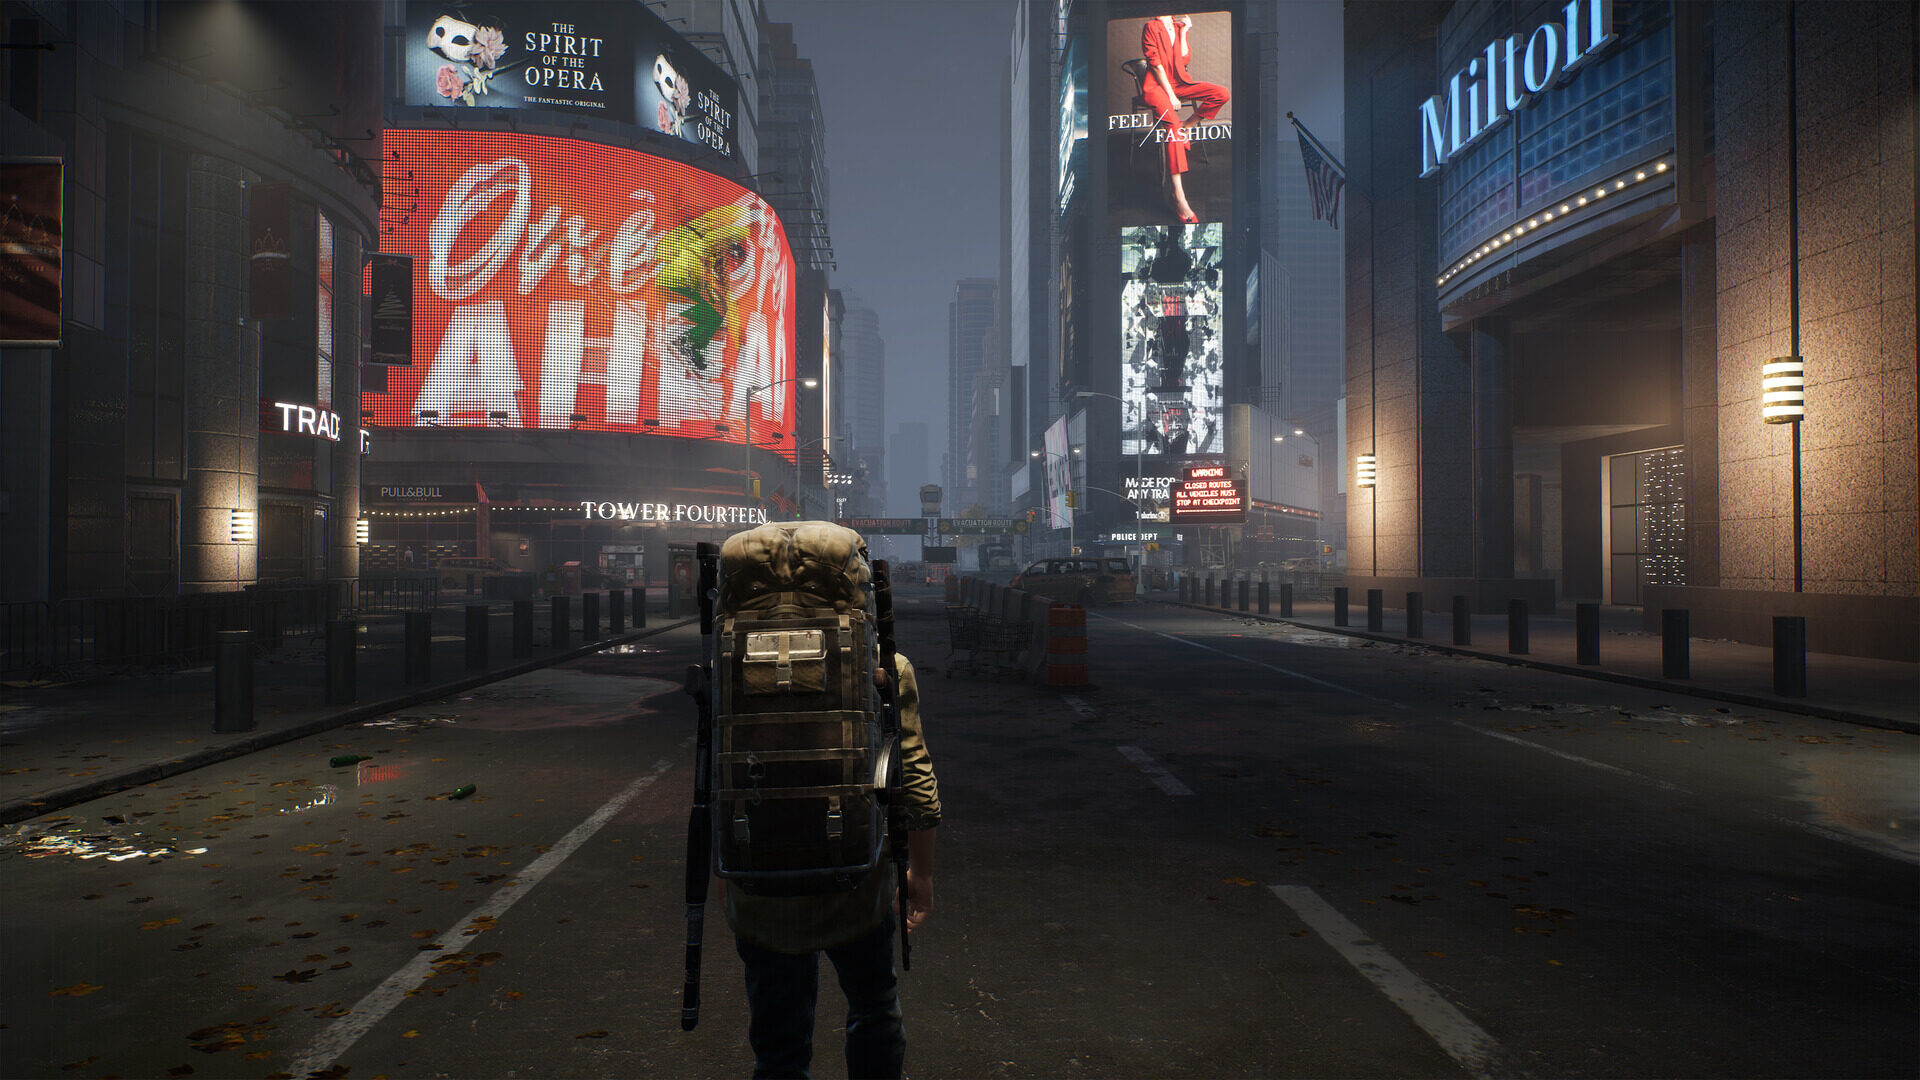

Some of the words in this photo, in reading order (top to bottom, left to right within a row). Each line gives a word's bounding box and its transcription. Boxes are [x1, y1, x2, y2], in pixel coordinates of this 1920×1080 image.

[551, 22, 575, 34] THE
[525, 32, 603, 57] SPIRIT
[542, 55, 558, 65] OF
[561, 56, 585, 68] THE
[525, 66, 604, 91] OPERA
[709, 88, 720, 103] THE
[1418, 0, 1614, 178] Milton
[523, 95, 537, 103] THE
[538, 97, 573, 106] FANTASTIC
[574, 99, 606, 109] ORIGINAL
[697, 91, 732, 129] SPIRIT
[705, 115, 712, 127] OF
[713, 121, 724, 136] THE
[1108, 113, 1153, 130] FEEL
[697, 122, 731, 157] OPERA
[1154, 124, 1231, 144] FASHION
[1192, 468, 1223, 477] WARNING
[1125, 477, 1155, 488] MADE
[1208, 480, 1232, 489] ROUTES
[381, 487, 443, 497] PULL&BULL
[1127, 488, 1149, 499] ANY
[1190, 490, 1219, 498] VEHICLES
[1220, 489, 1236, 497] MUST
[1176, 498, 1191, 506] STOP
[1192, 498, 1201, 506] AT
[1202, 497, 1241, 506] CHECKPOINT
[581, 501, 670, 521] TOWER
[675, 504, 767, 524] FOURTEEN
[952, 519, 991, 528] EVACUATION
[1111, 533, 1137, 541] POLICE
